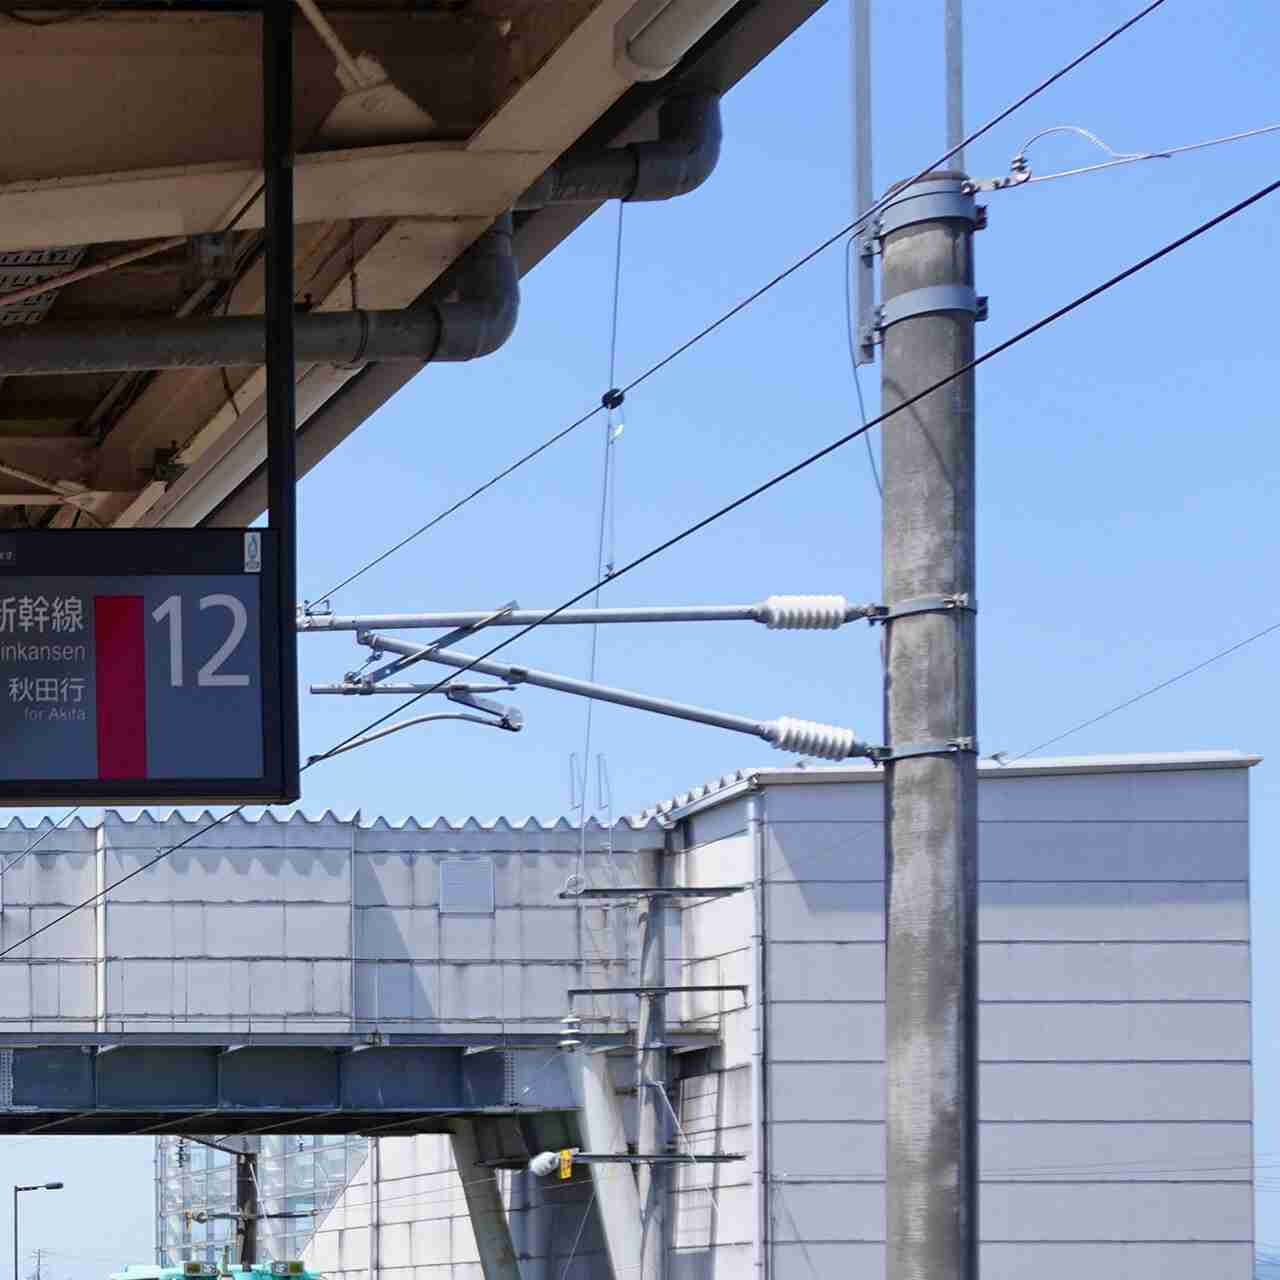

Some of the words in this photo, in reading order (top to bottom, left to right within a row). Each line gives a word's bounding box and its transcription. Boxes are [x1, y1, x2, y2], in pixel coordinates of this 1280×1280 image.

[152, 593, 250, 686] 12
[8, 677, 86, 703] 秋田行
[23, 706, 44, 721] for
[48, 706, 88, 721] Akita
